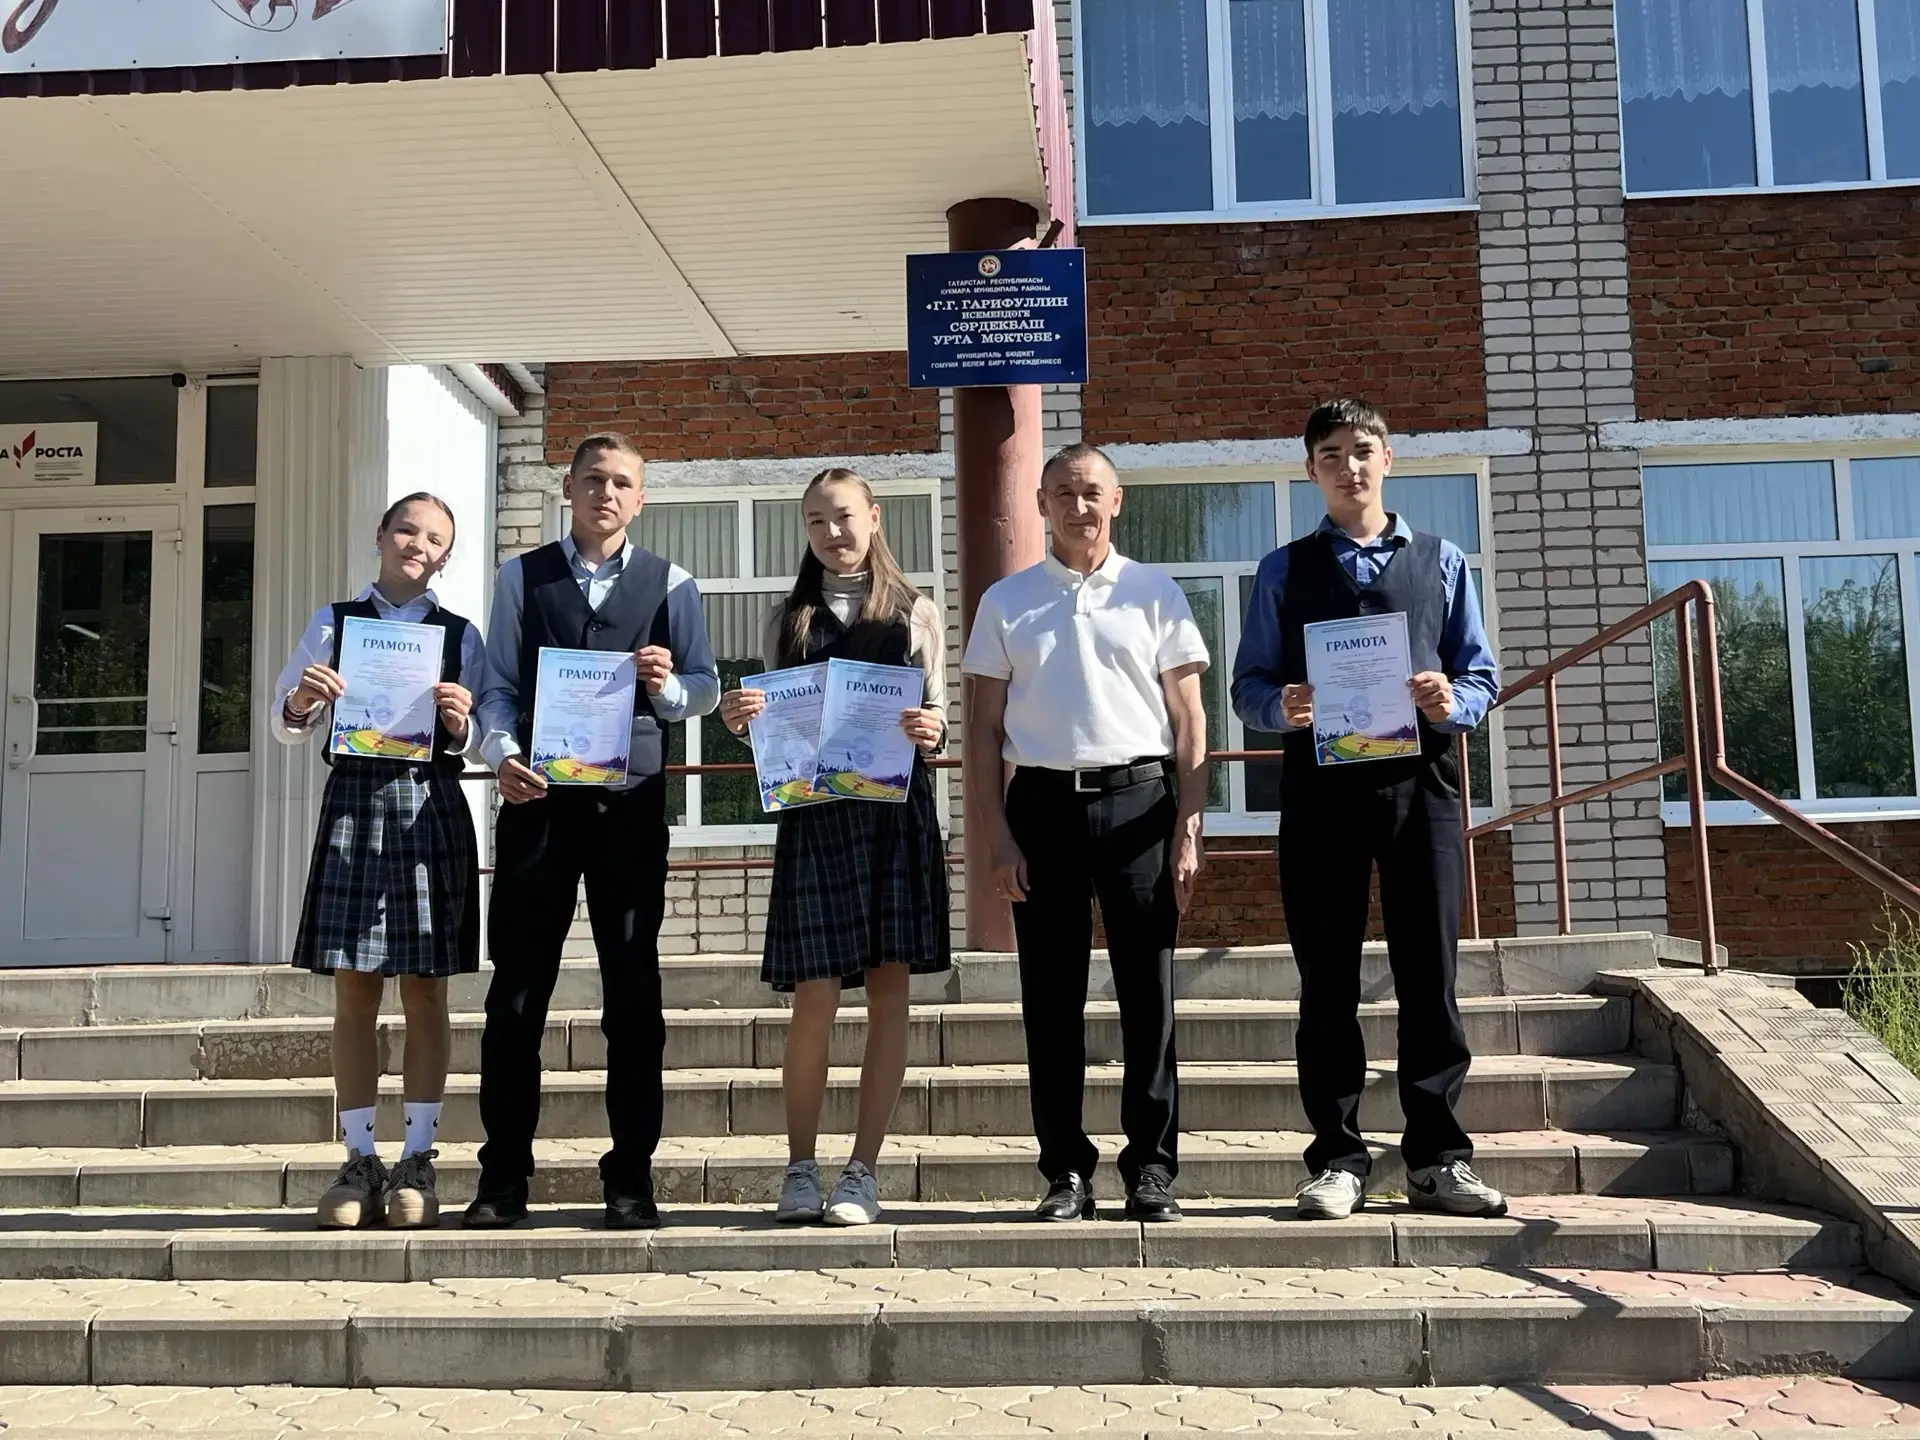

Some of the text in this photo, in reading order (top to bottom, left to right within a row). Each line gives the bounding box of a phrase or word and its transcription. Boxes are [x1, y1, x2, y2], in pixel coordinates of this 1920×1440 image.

[948, 277, 1043, 287] ТАТАРСТАН РЕСПУБЛИКАСЫ
[941, 287, 971, 295] КУКМАРА
[974, 286, 1018, 294] МУНИЦИПАЛЬ
[961, 297, 1068, 310] ГАРИФУЛЛИН
[950, 319, 1045, 333] СӘРДЕКБАШ
[932, 334, 973, 346] УРТА
[1005, 350, 1036, 358] БЮДЖЕТ
[35, 446, 84, 458] РОСТА
[362, 638, 422, 653] ГРАМОТА
[1325, 635, 1387, 652] ГРАМОТА
[559, 668, 617, 681] ГРАМОТА
[764, 684, 822, 703] ГРАМОТА
[846, 680, 903, 697] ГРАМОТА
